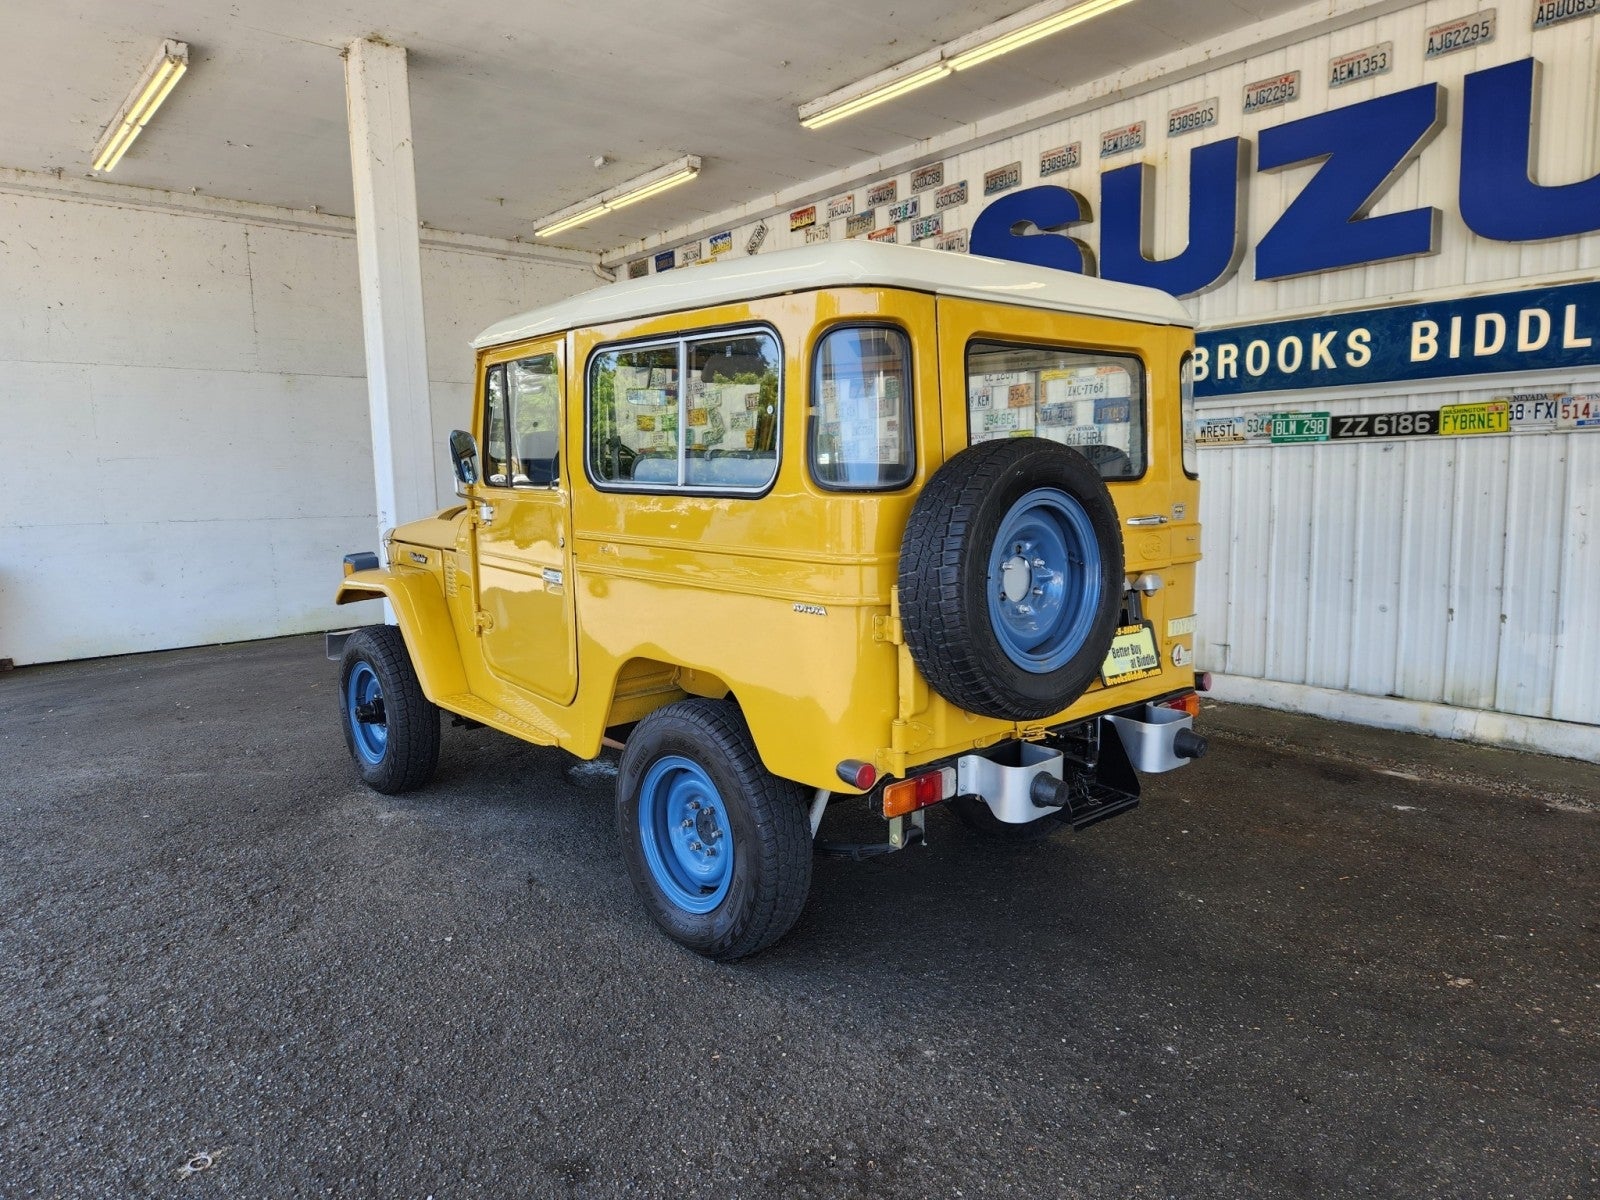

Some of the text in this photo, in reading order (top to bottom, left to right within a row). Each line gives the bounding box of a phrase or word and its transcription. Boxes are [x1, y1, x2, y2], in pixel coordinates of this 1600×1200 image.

[1427, 20, 1490, 54] AJG2295
[1331, 52, 1387, 83] AEW1353
[1244, 81, 1295, 110] AJG2295
[1193, 304, 1592, 382] BROOKS BIDDL
[1513, 394, 1549, 402] NEVADA
[1443, 406, 1486, 415] WASHINGTON
[1562, 403, 1590, 419] 514
[1276, 420, 1324, 435] BLM 298
[1339, 413, 1431, 436] ZZ 6186
[1111, 644, 1142, 659] Better Buy
[1136, 654, 1156, 667] Biddle
